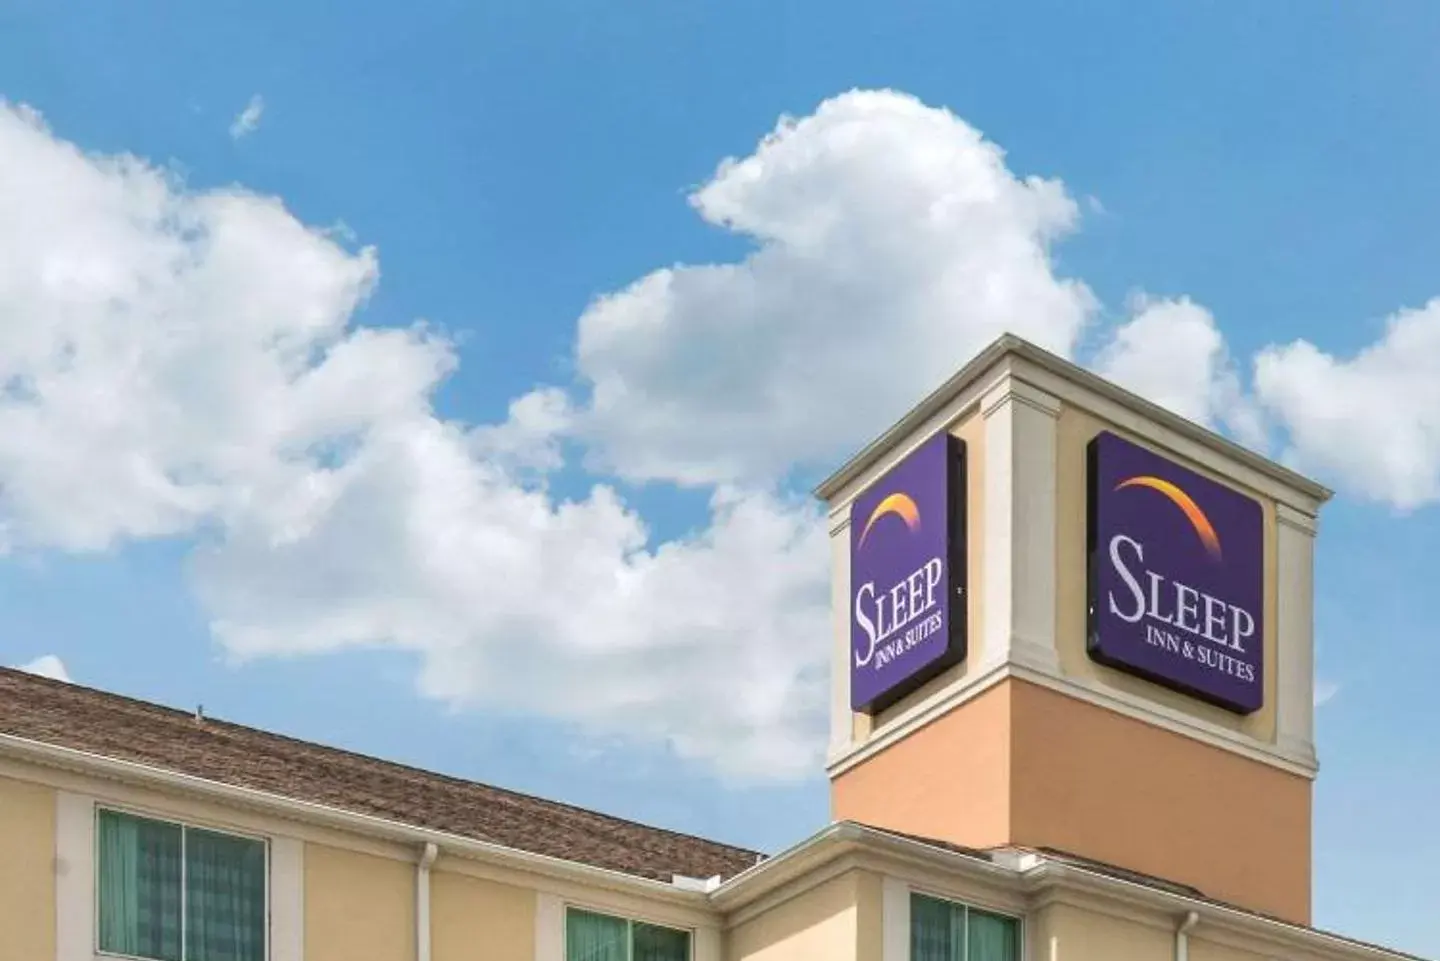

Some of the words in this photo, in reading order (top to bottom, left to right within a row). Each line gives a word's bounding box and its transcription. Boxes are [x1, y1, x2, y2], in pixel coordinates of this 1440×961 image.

[855, 557, 942, 669] SLEEP
[1108, 534, 1255, 653] SLEEP
[875, 641, 896, 671] INN
[896, 637, 904, 656] &
[905, 609, 942, 651] SUITES
[1146, 624, 1180, 654] INN
[1182, 640, 1195, 660] &
[1197, 644, 1255, 683] SUITES
